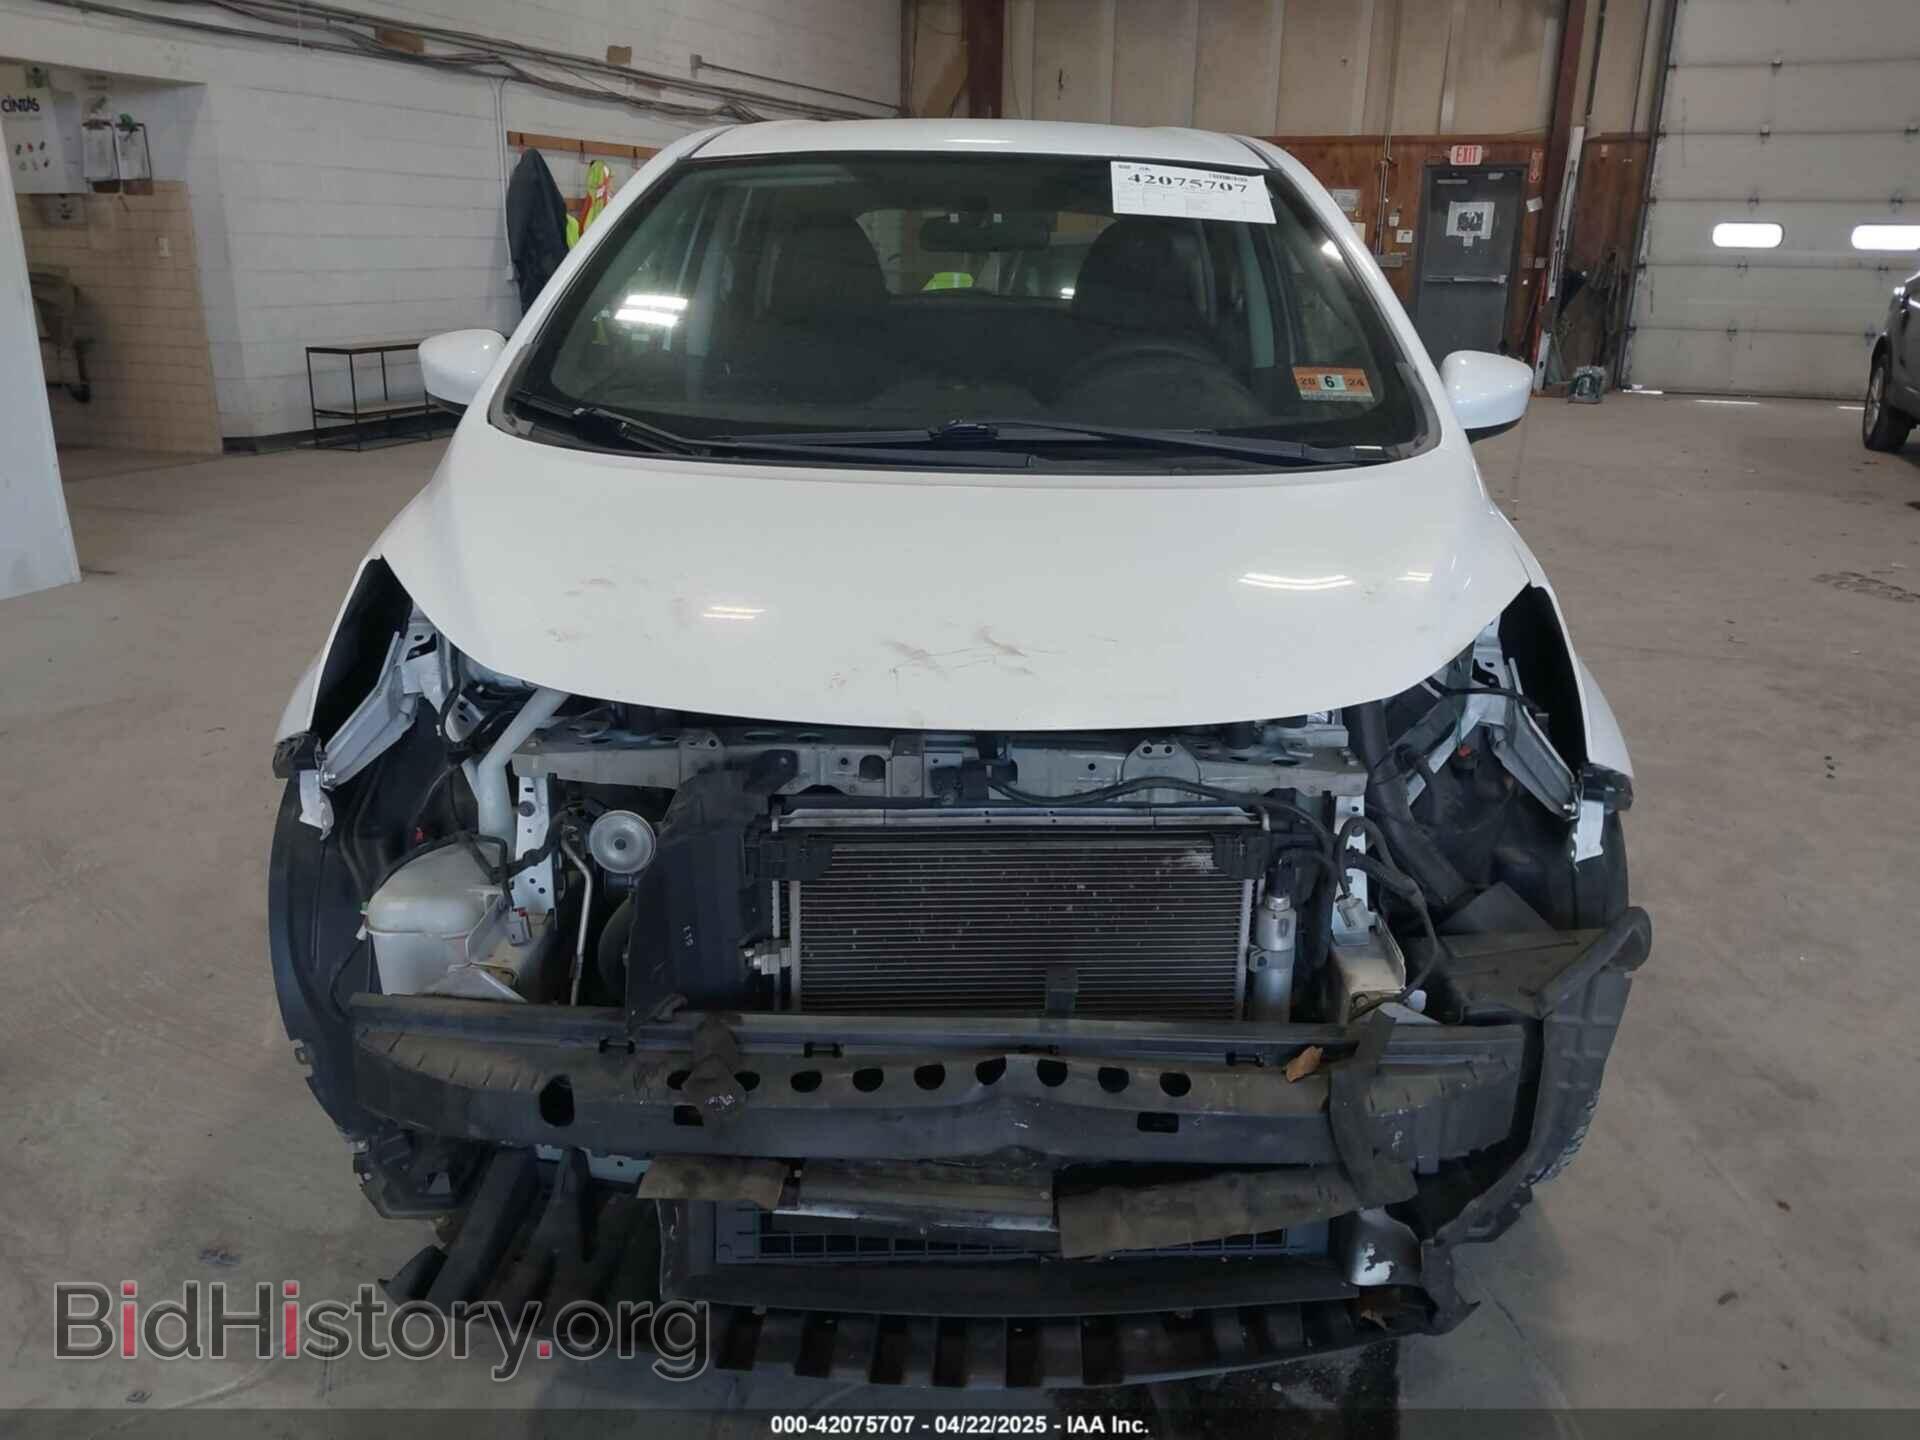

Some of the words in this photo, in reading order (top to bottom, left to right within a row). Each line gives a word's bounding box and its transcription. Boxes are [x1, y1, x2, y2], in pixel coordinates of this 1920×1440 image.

[1456, 146, 1478, 164] EXIT
[1127, 173, 1248, 193] 42075707
[1324, 375, 1335, 389] 6
